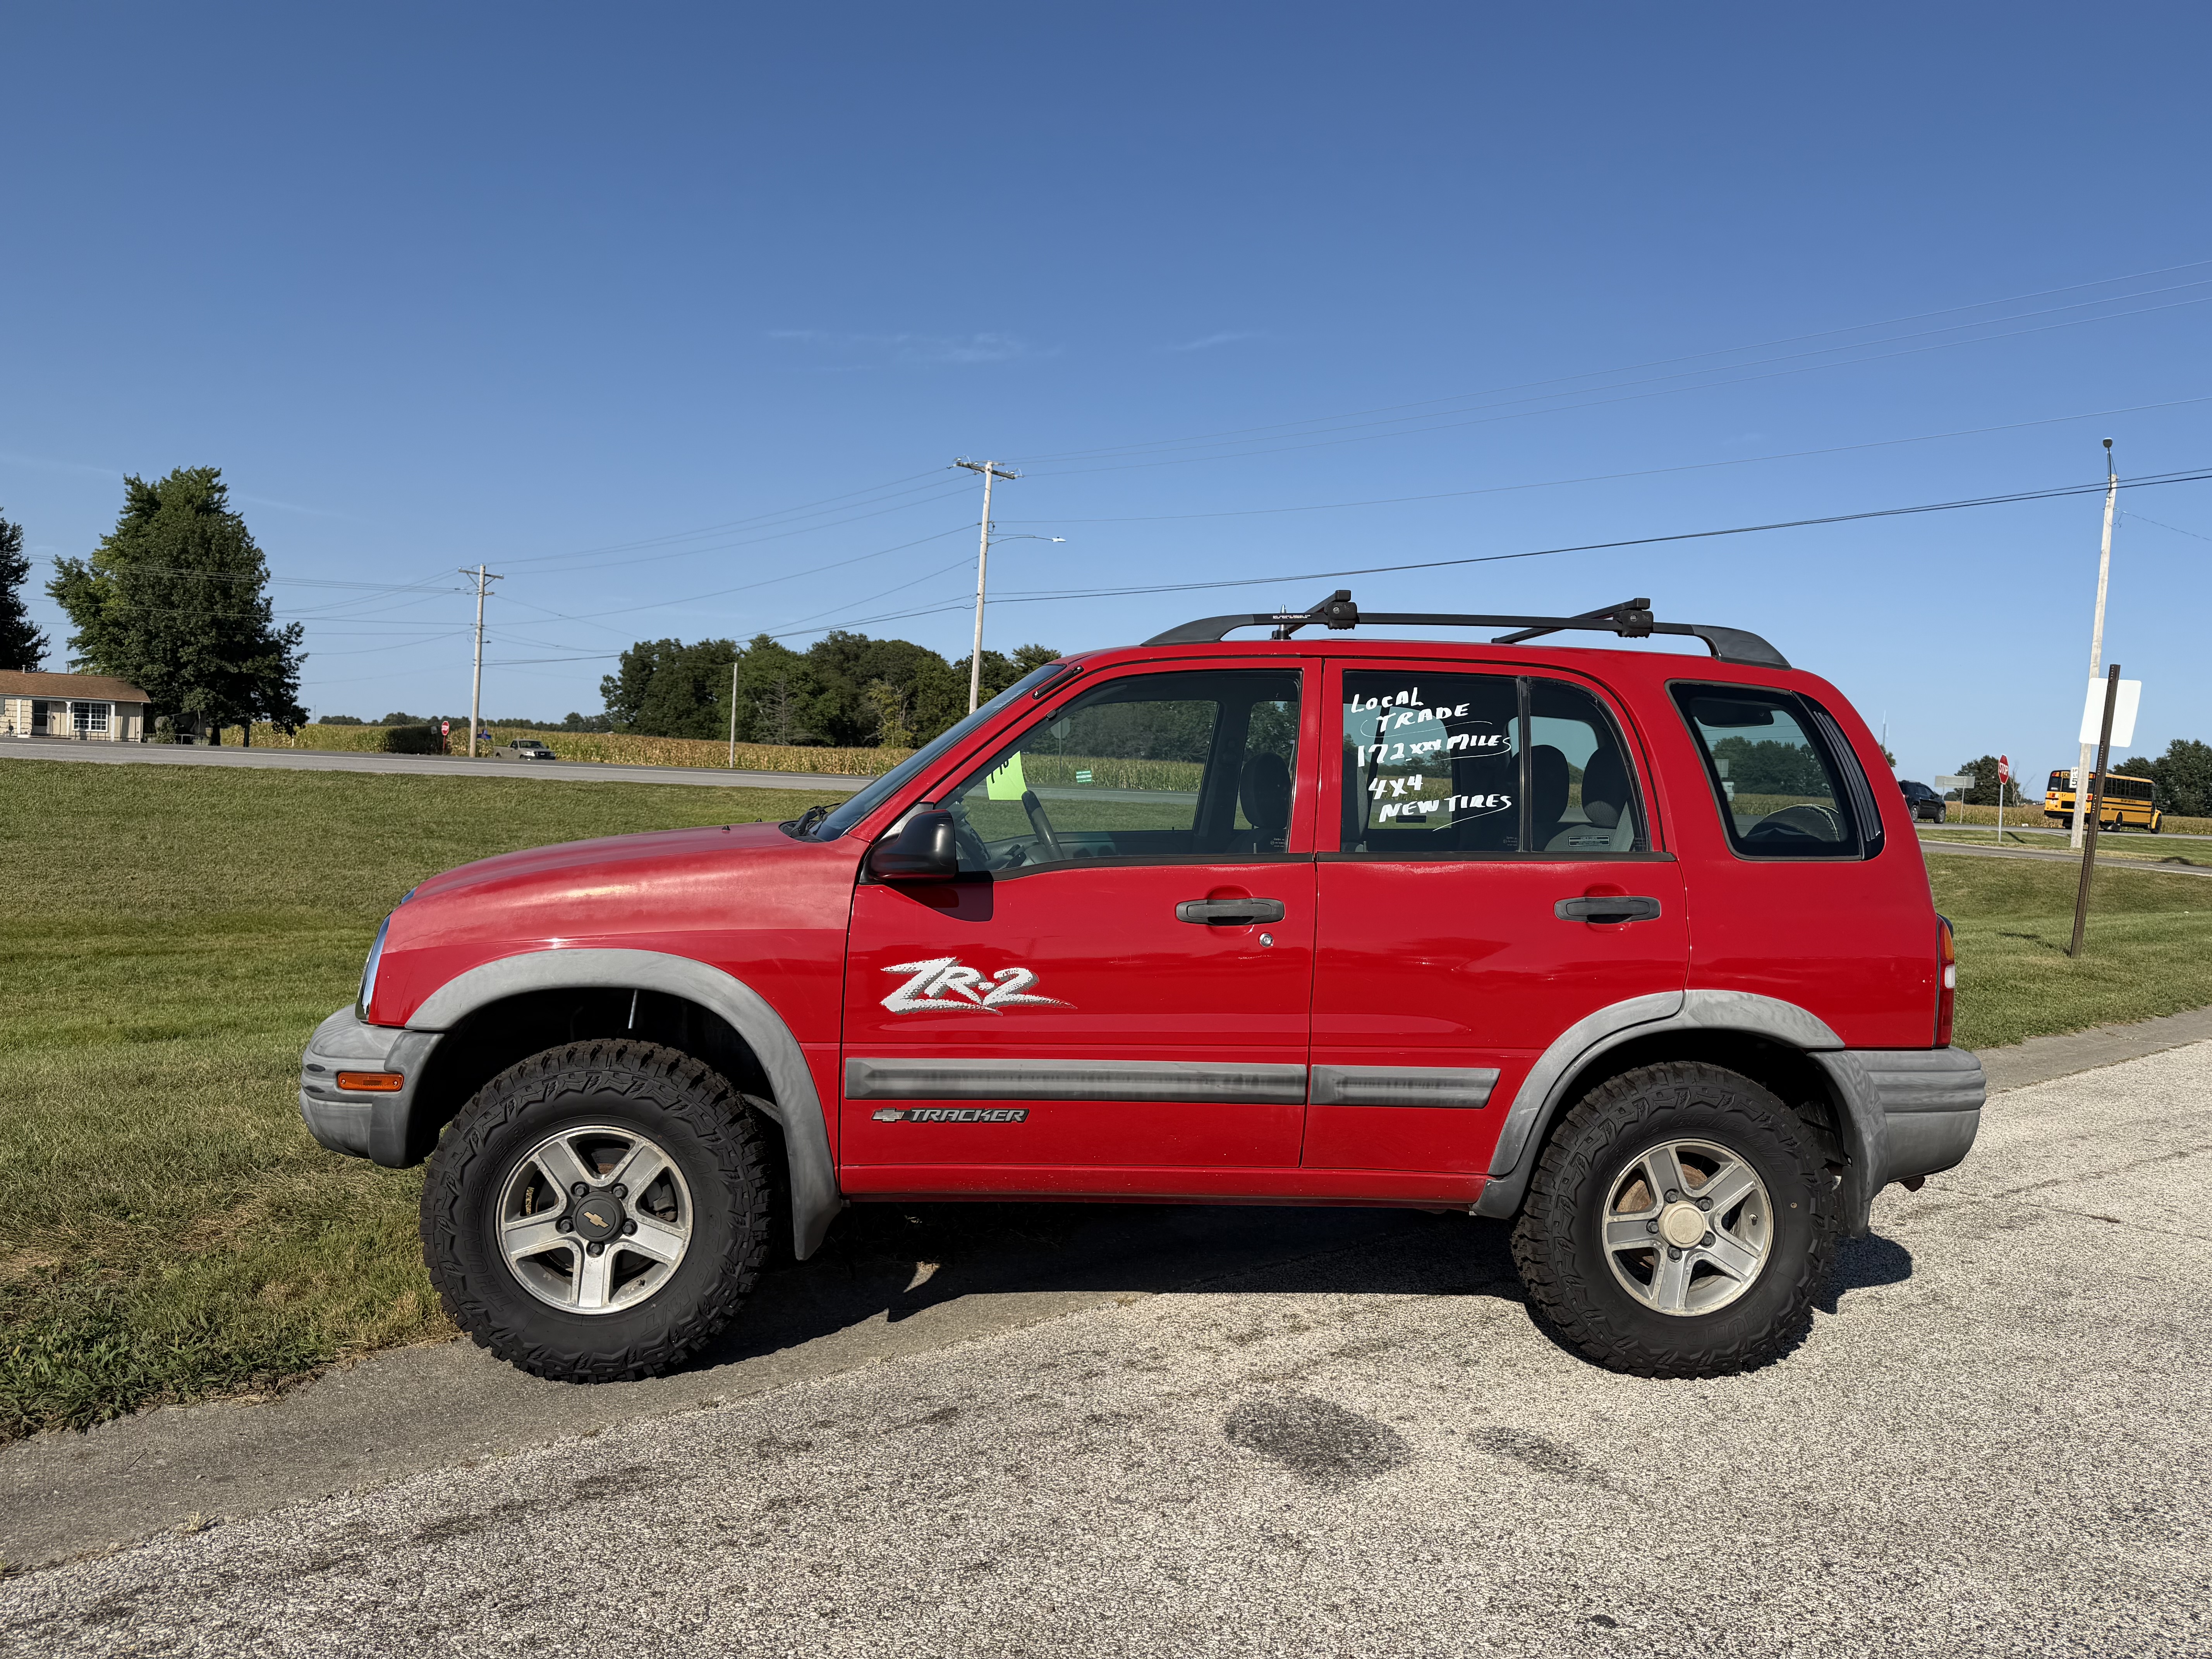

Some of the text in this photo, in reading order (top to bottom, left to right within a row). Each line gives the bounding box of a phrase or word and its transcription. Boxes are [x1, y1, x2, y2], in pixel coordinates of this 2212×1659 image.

[1350, 687, 1424, 713] LOCAL
[1376, 703, 1470, 733] TRADE
[1446, 734, 1511, 752] MILES
[1999, 762, 2008, 776] STOP
[1379, 794, 1512, 823] NEW TIRES
[879, 956, 1078, 1016] ZR-2
[911, 1109, 1025, 1121] TRACKER
[1670, 1113, 1747, 1132] GRIP
[1743, 1133, 1795, 1176] M/T
[462, 1120, 527, 1313] THUNDERER
[640, 1121, 723, 1338] TRAC GRIP M/T
